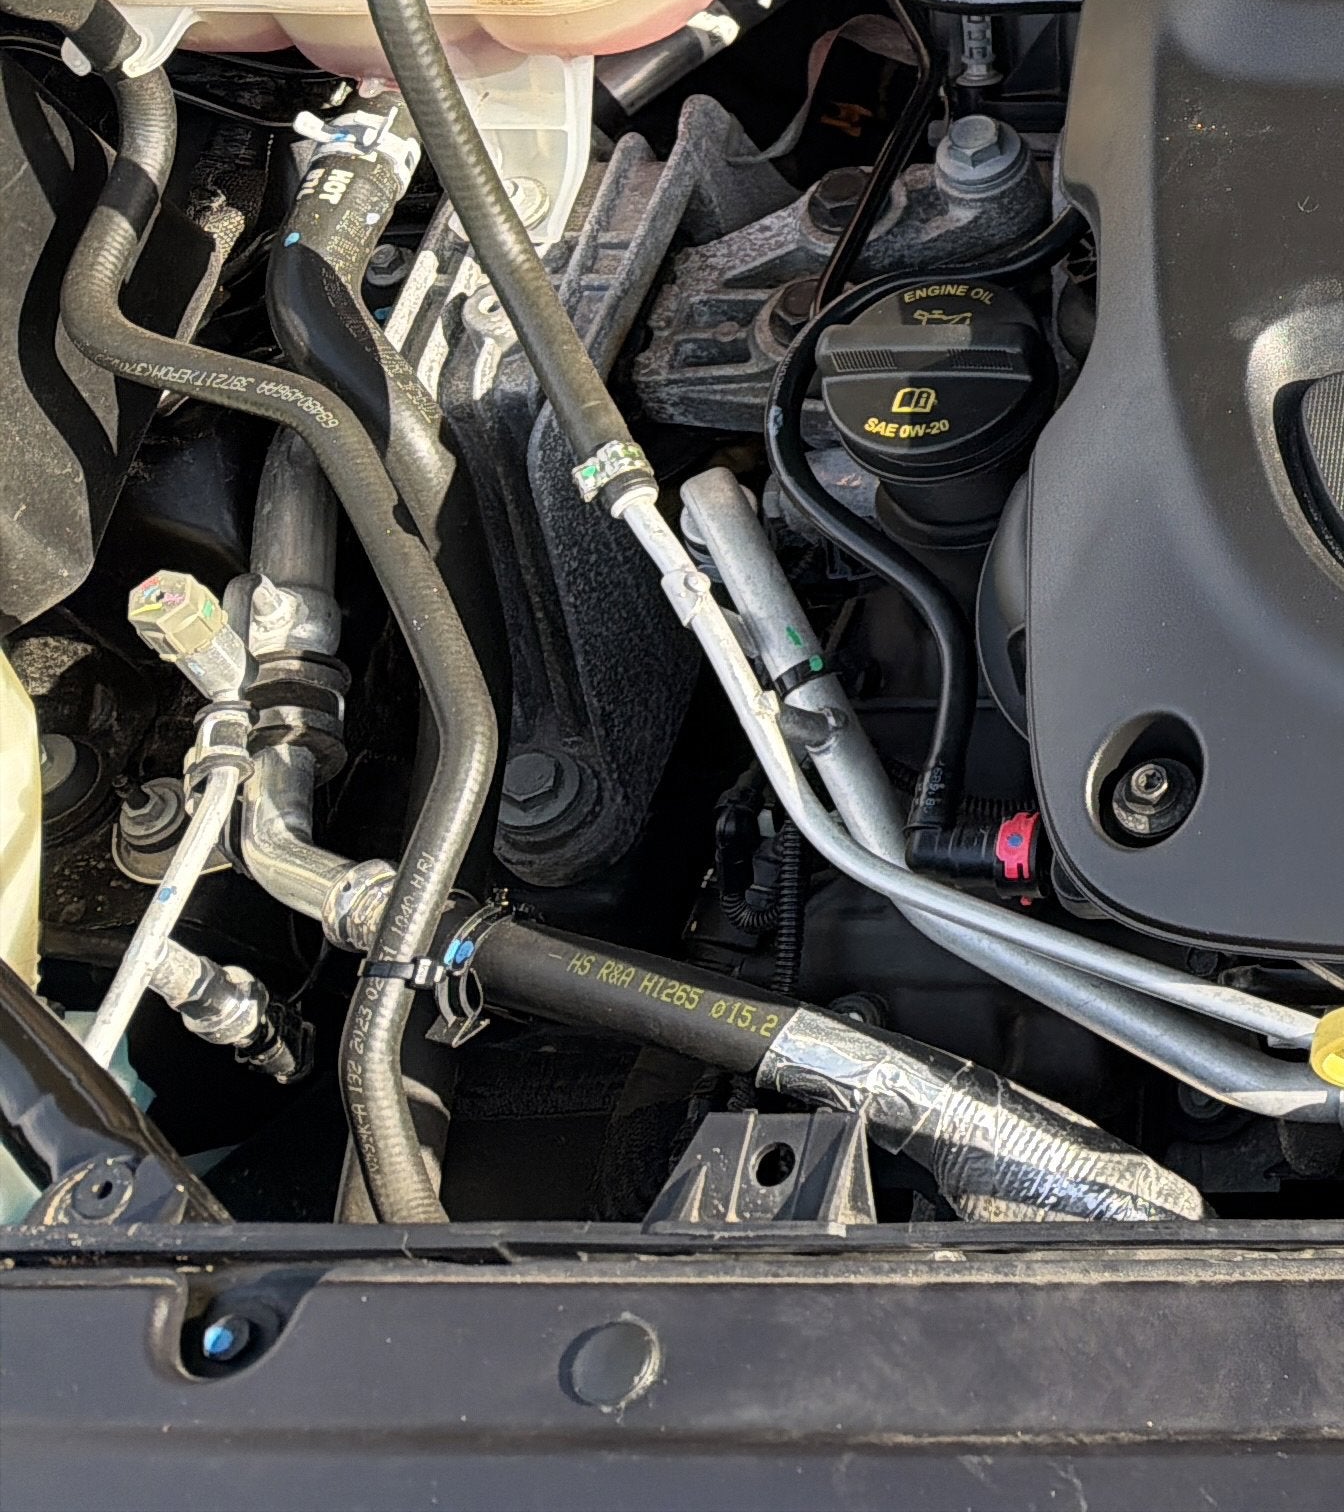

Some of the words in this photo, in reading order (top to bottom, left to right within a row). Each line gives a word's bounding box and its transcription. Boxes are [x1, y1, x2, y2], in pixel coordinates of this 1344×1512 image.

[319, 169, 354, 205] HOT
[903, 284, 970, 304] ENGINE
[971, 288, 995, 305] OIL
[863, 417, 899, 438] SAE
[899, 419, 949, 438] 0W-20
[566, 952, 596, 976] HS
[596, 959, 636, 988] R&A
[638, 972, 705, 1010] H1265
